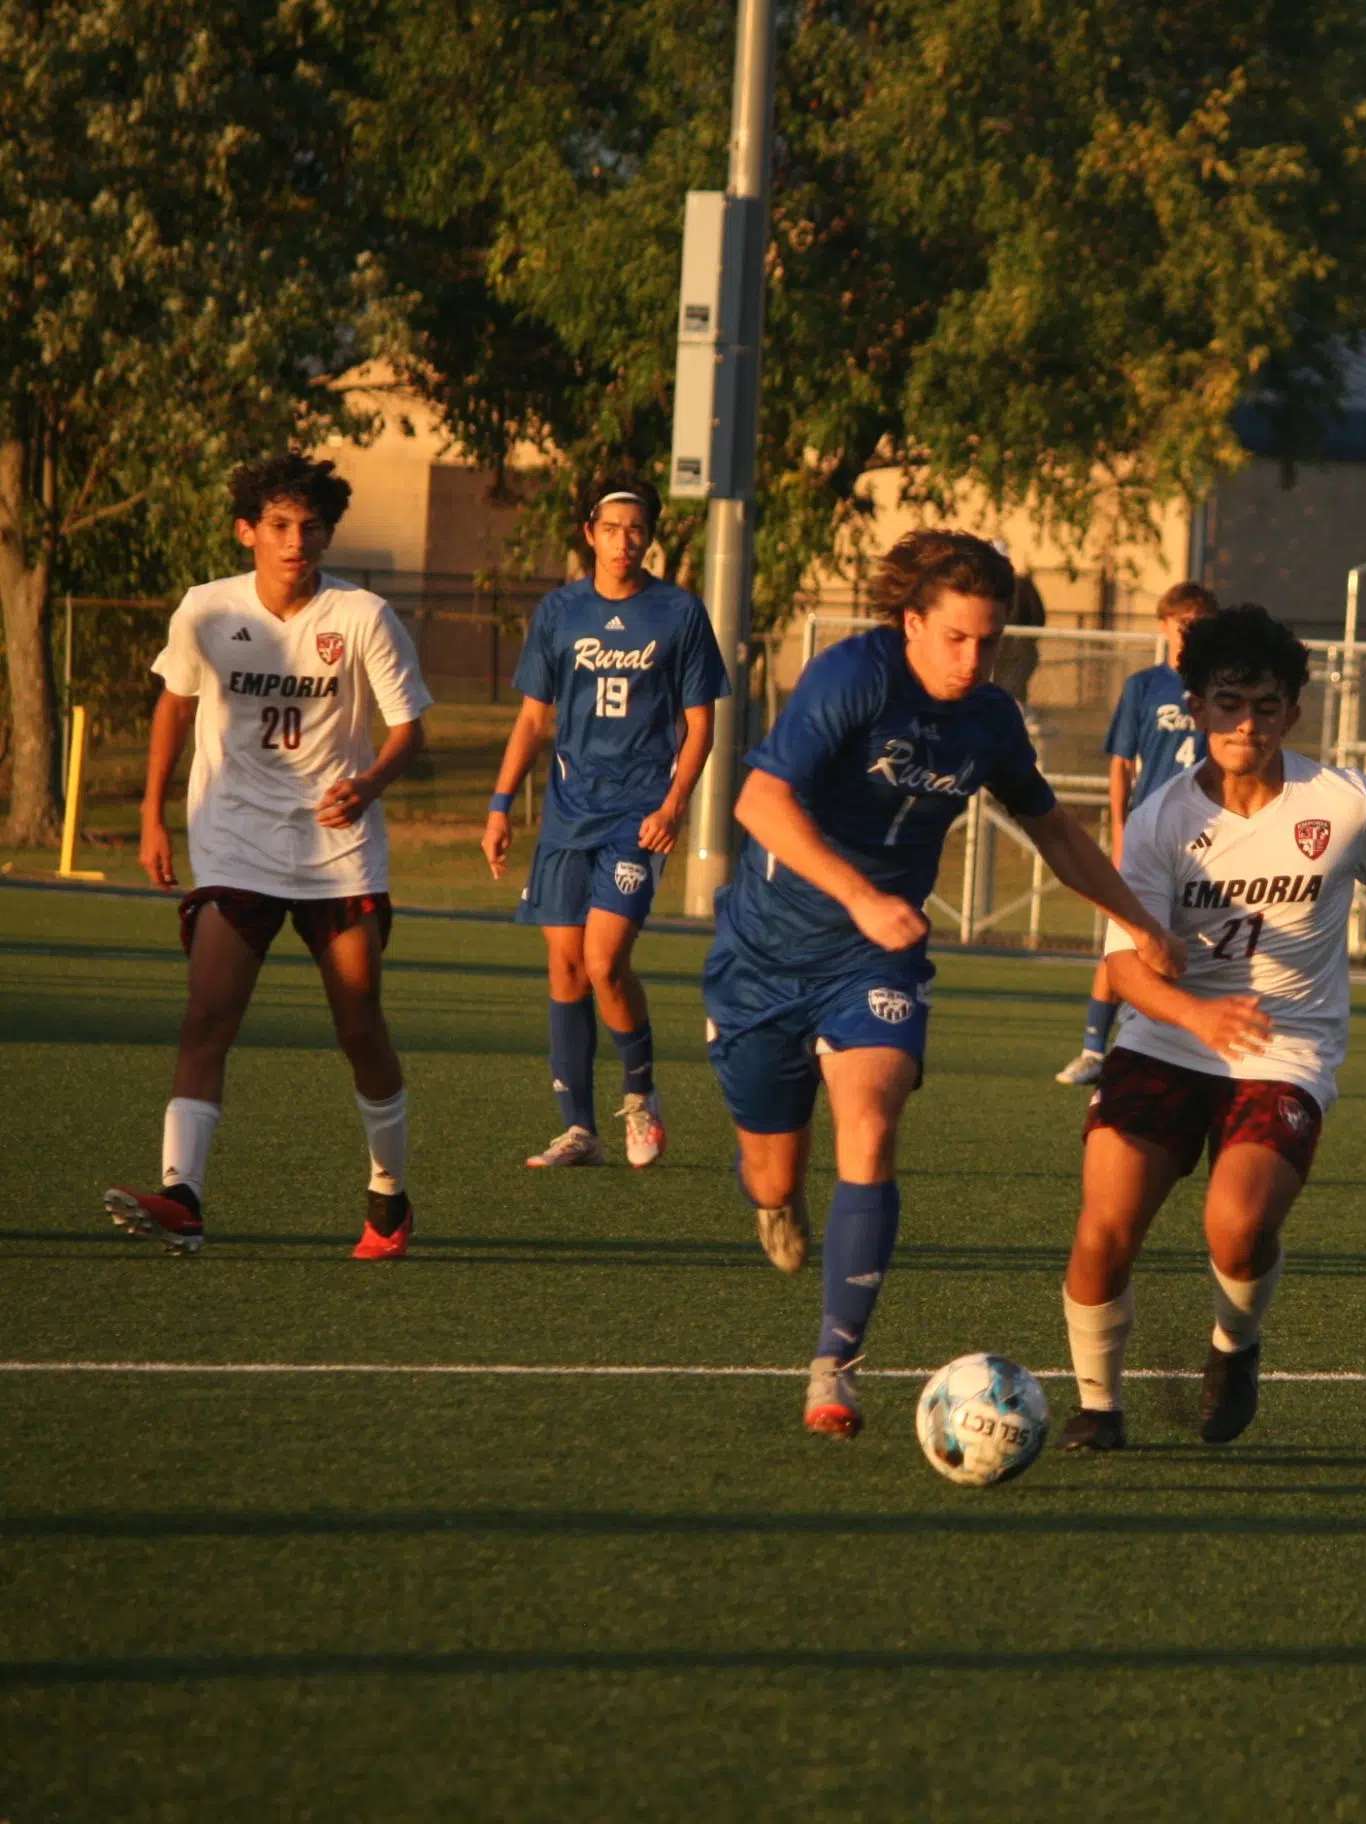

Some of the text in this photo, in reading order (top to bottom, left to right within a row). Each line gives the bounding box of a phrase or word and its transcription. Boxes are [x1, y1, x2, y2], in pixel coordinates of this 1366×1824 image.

[573, 637, 656, 672] Rural
[228, 671, 339, 698] EMPORIA
[595, 677, 628, 718] 19
[261, 706, 301, 750] 20
[1156, 704, 1196, 732] Rur
[867, 739, 975, 796] Rural
[1175, 736, 1196, 768] 4
[1182, 875, 1323, 908] EMPORIA
[1212, 912, 1265, 960] 21
[960, 1411, 1031, 1447] SELECT
